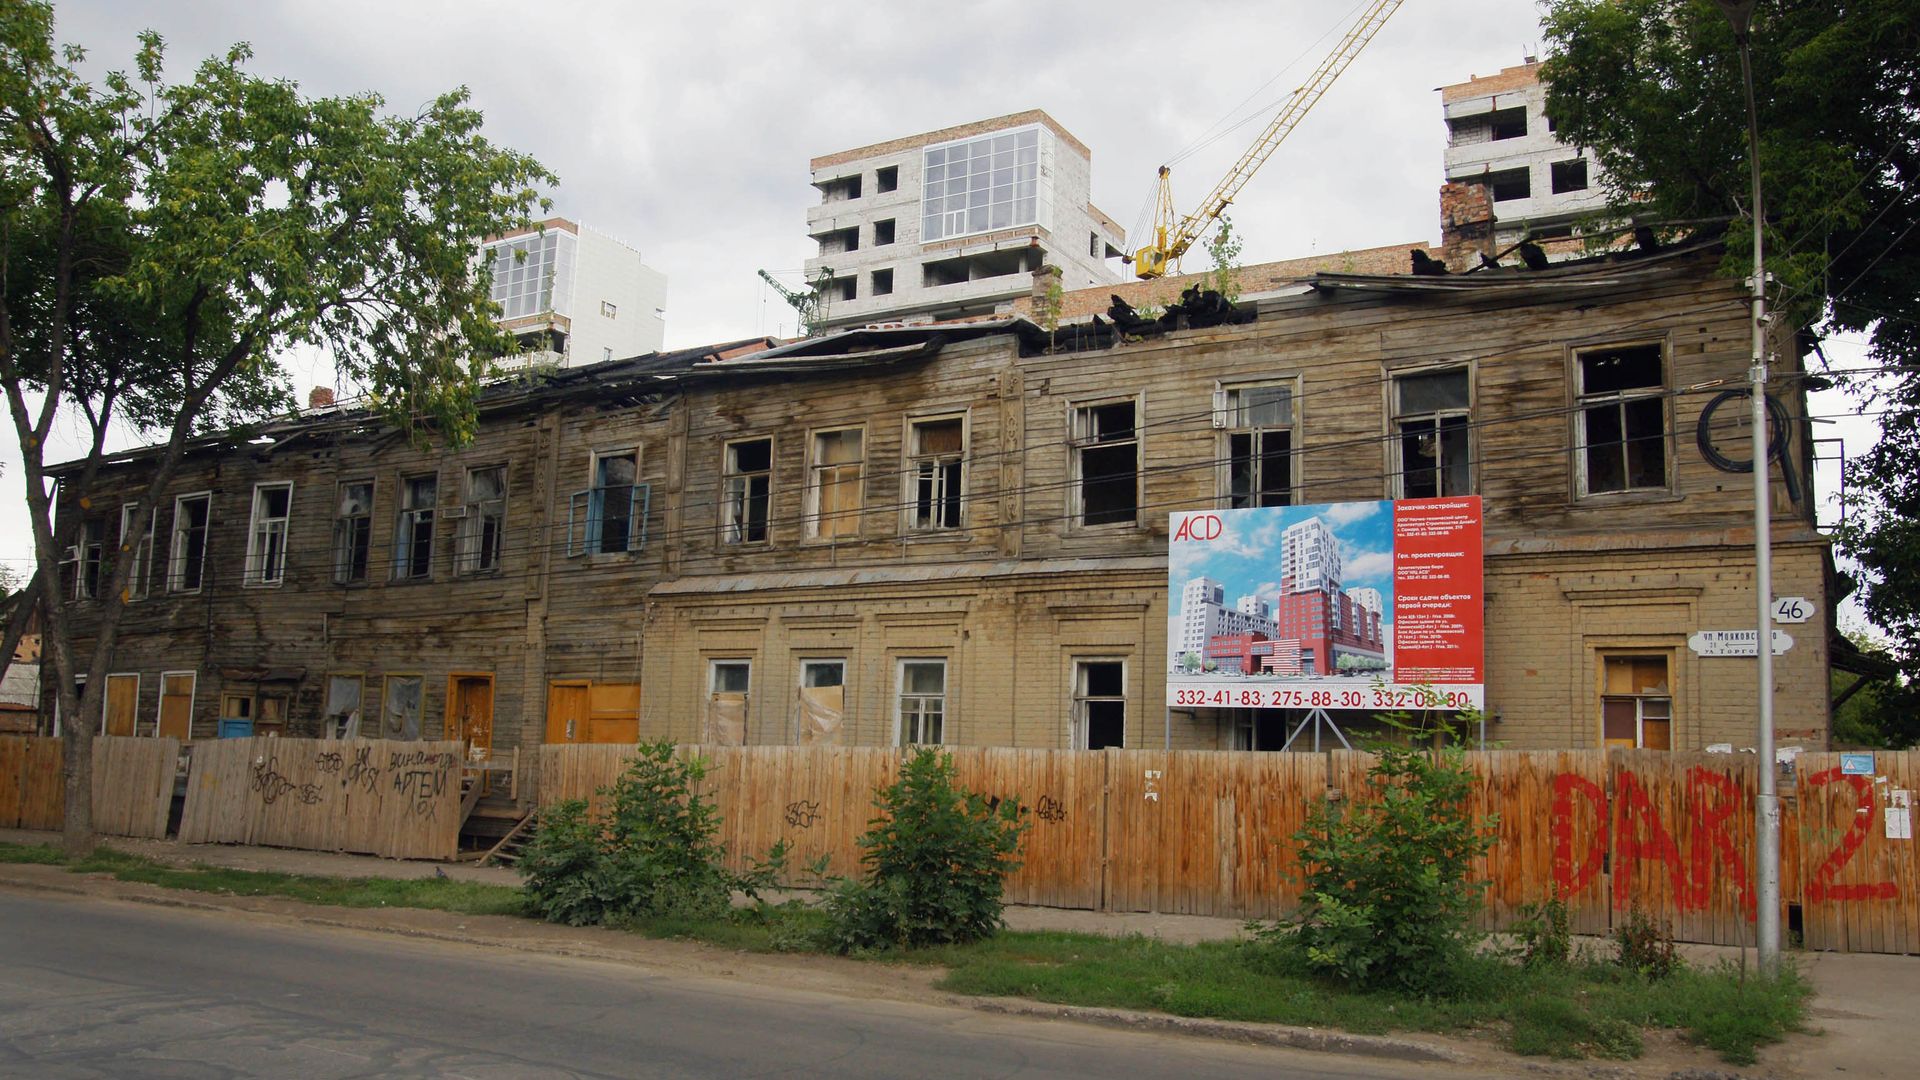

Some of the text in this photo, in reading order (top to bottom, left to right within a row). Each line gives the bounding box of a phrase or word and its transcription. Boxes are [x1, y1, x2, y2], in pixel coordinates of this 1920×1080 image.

[1174, 514, 1222, 542] ACD
[1398, 595, 1418, 603] Сроки
[1779, 601, 1803, 618] 46
[1176, 690, 1265, 707] 332-41-83;
[1272, 690, 1366, 708] 275-88-30;
[1552, 765, 1899, 922] DAR 2
